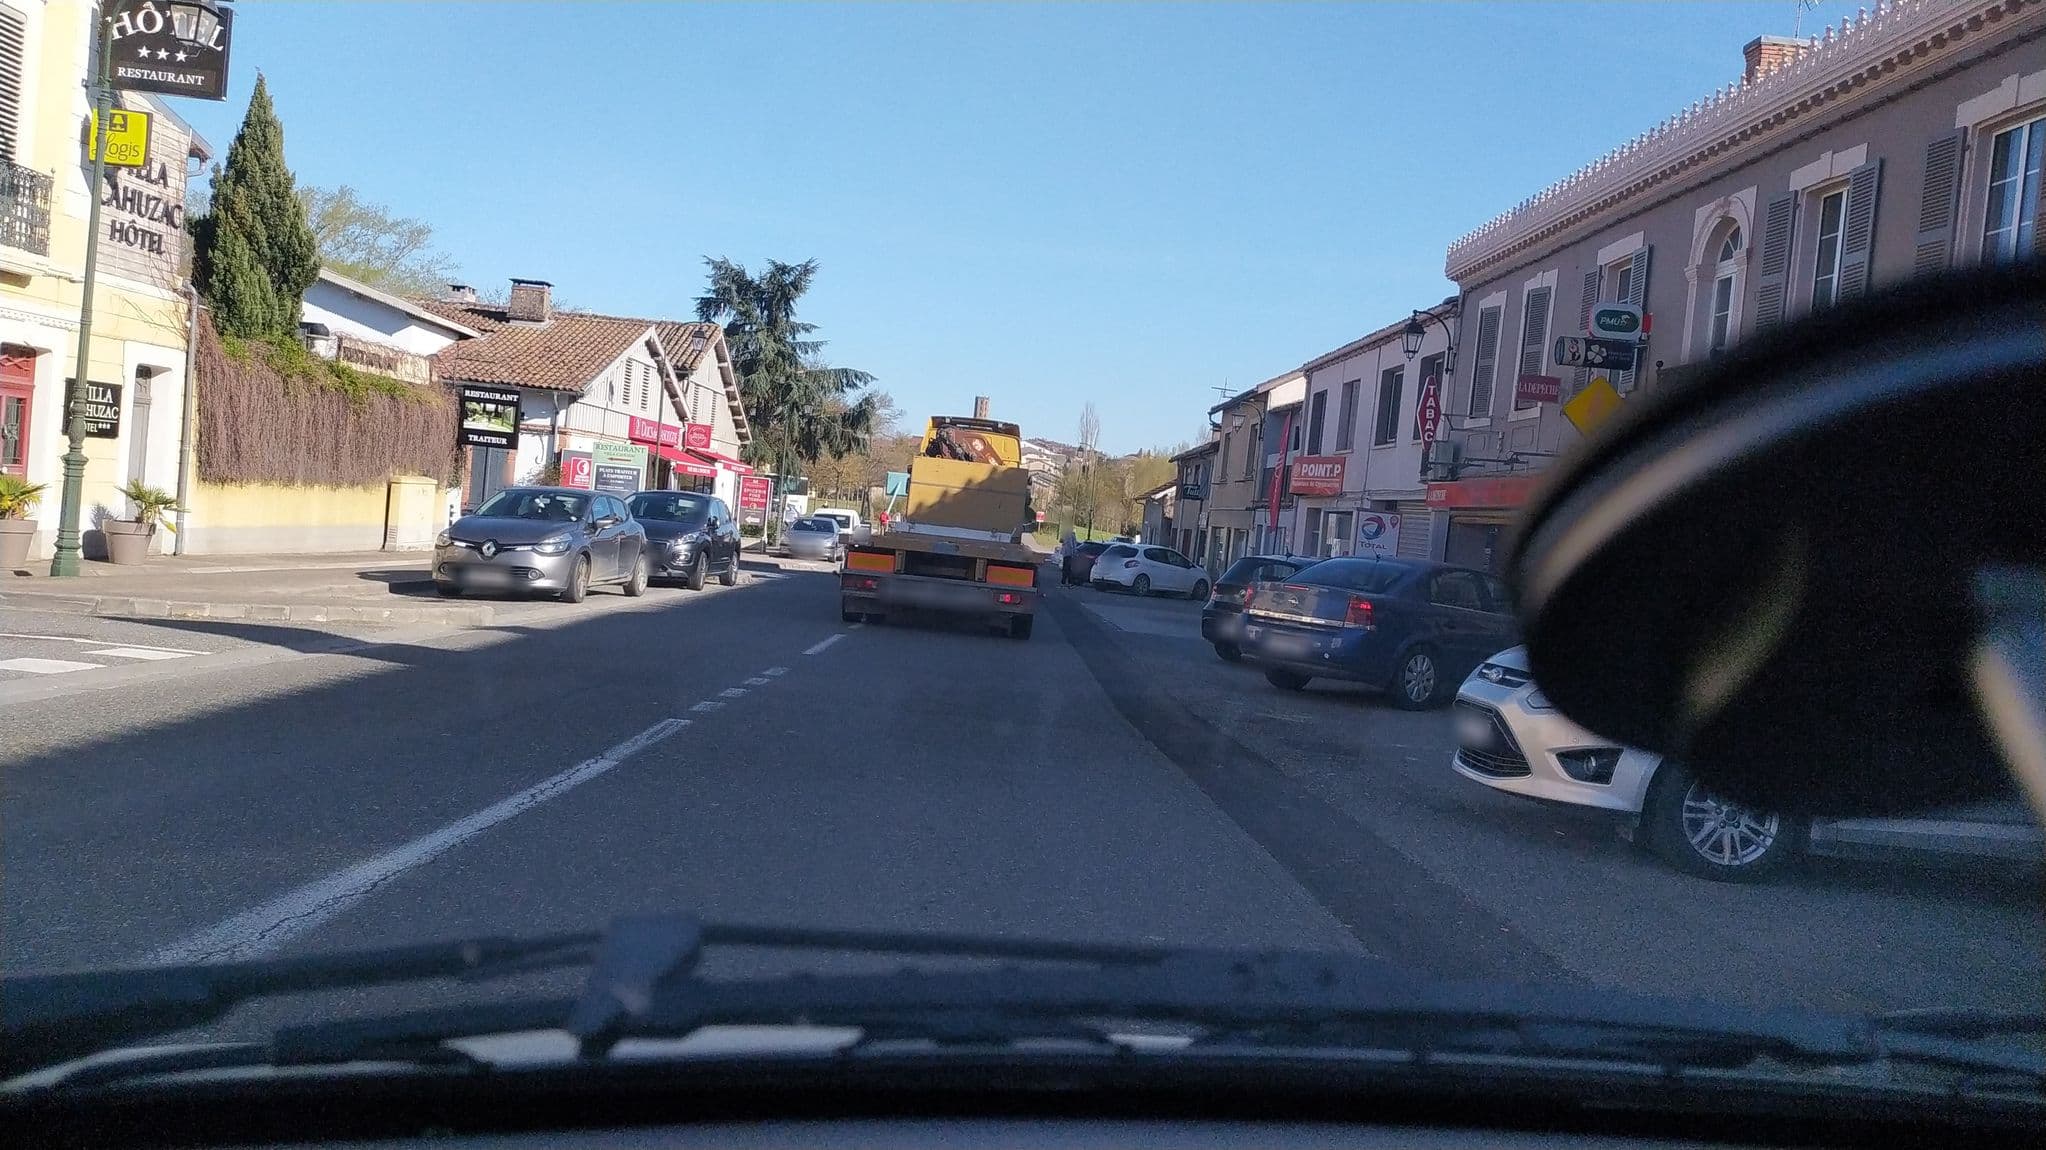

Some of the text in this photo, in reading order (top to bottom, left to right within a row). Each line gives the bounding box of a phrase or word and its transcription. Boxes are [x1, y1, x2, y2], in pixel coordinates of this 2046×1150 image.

[117, 66, 205, 86] RESTAURANT
[109, 219, 166, 255] HÔTEL
[1600, 316, 1620, 326] PMU
[86, 384, 113, 403] ILLA
[464, 389, 519, 402] RESTAURANT
[1424, 385, 1436, 442] TABAC
[467, 434, 508, 445] TRAITEUR
[595, 443, 645, 455] RESTAURANT
[1301, 462, 1342, 478] POINT.P
[1360, 541, 1387, 550] TOTAL
